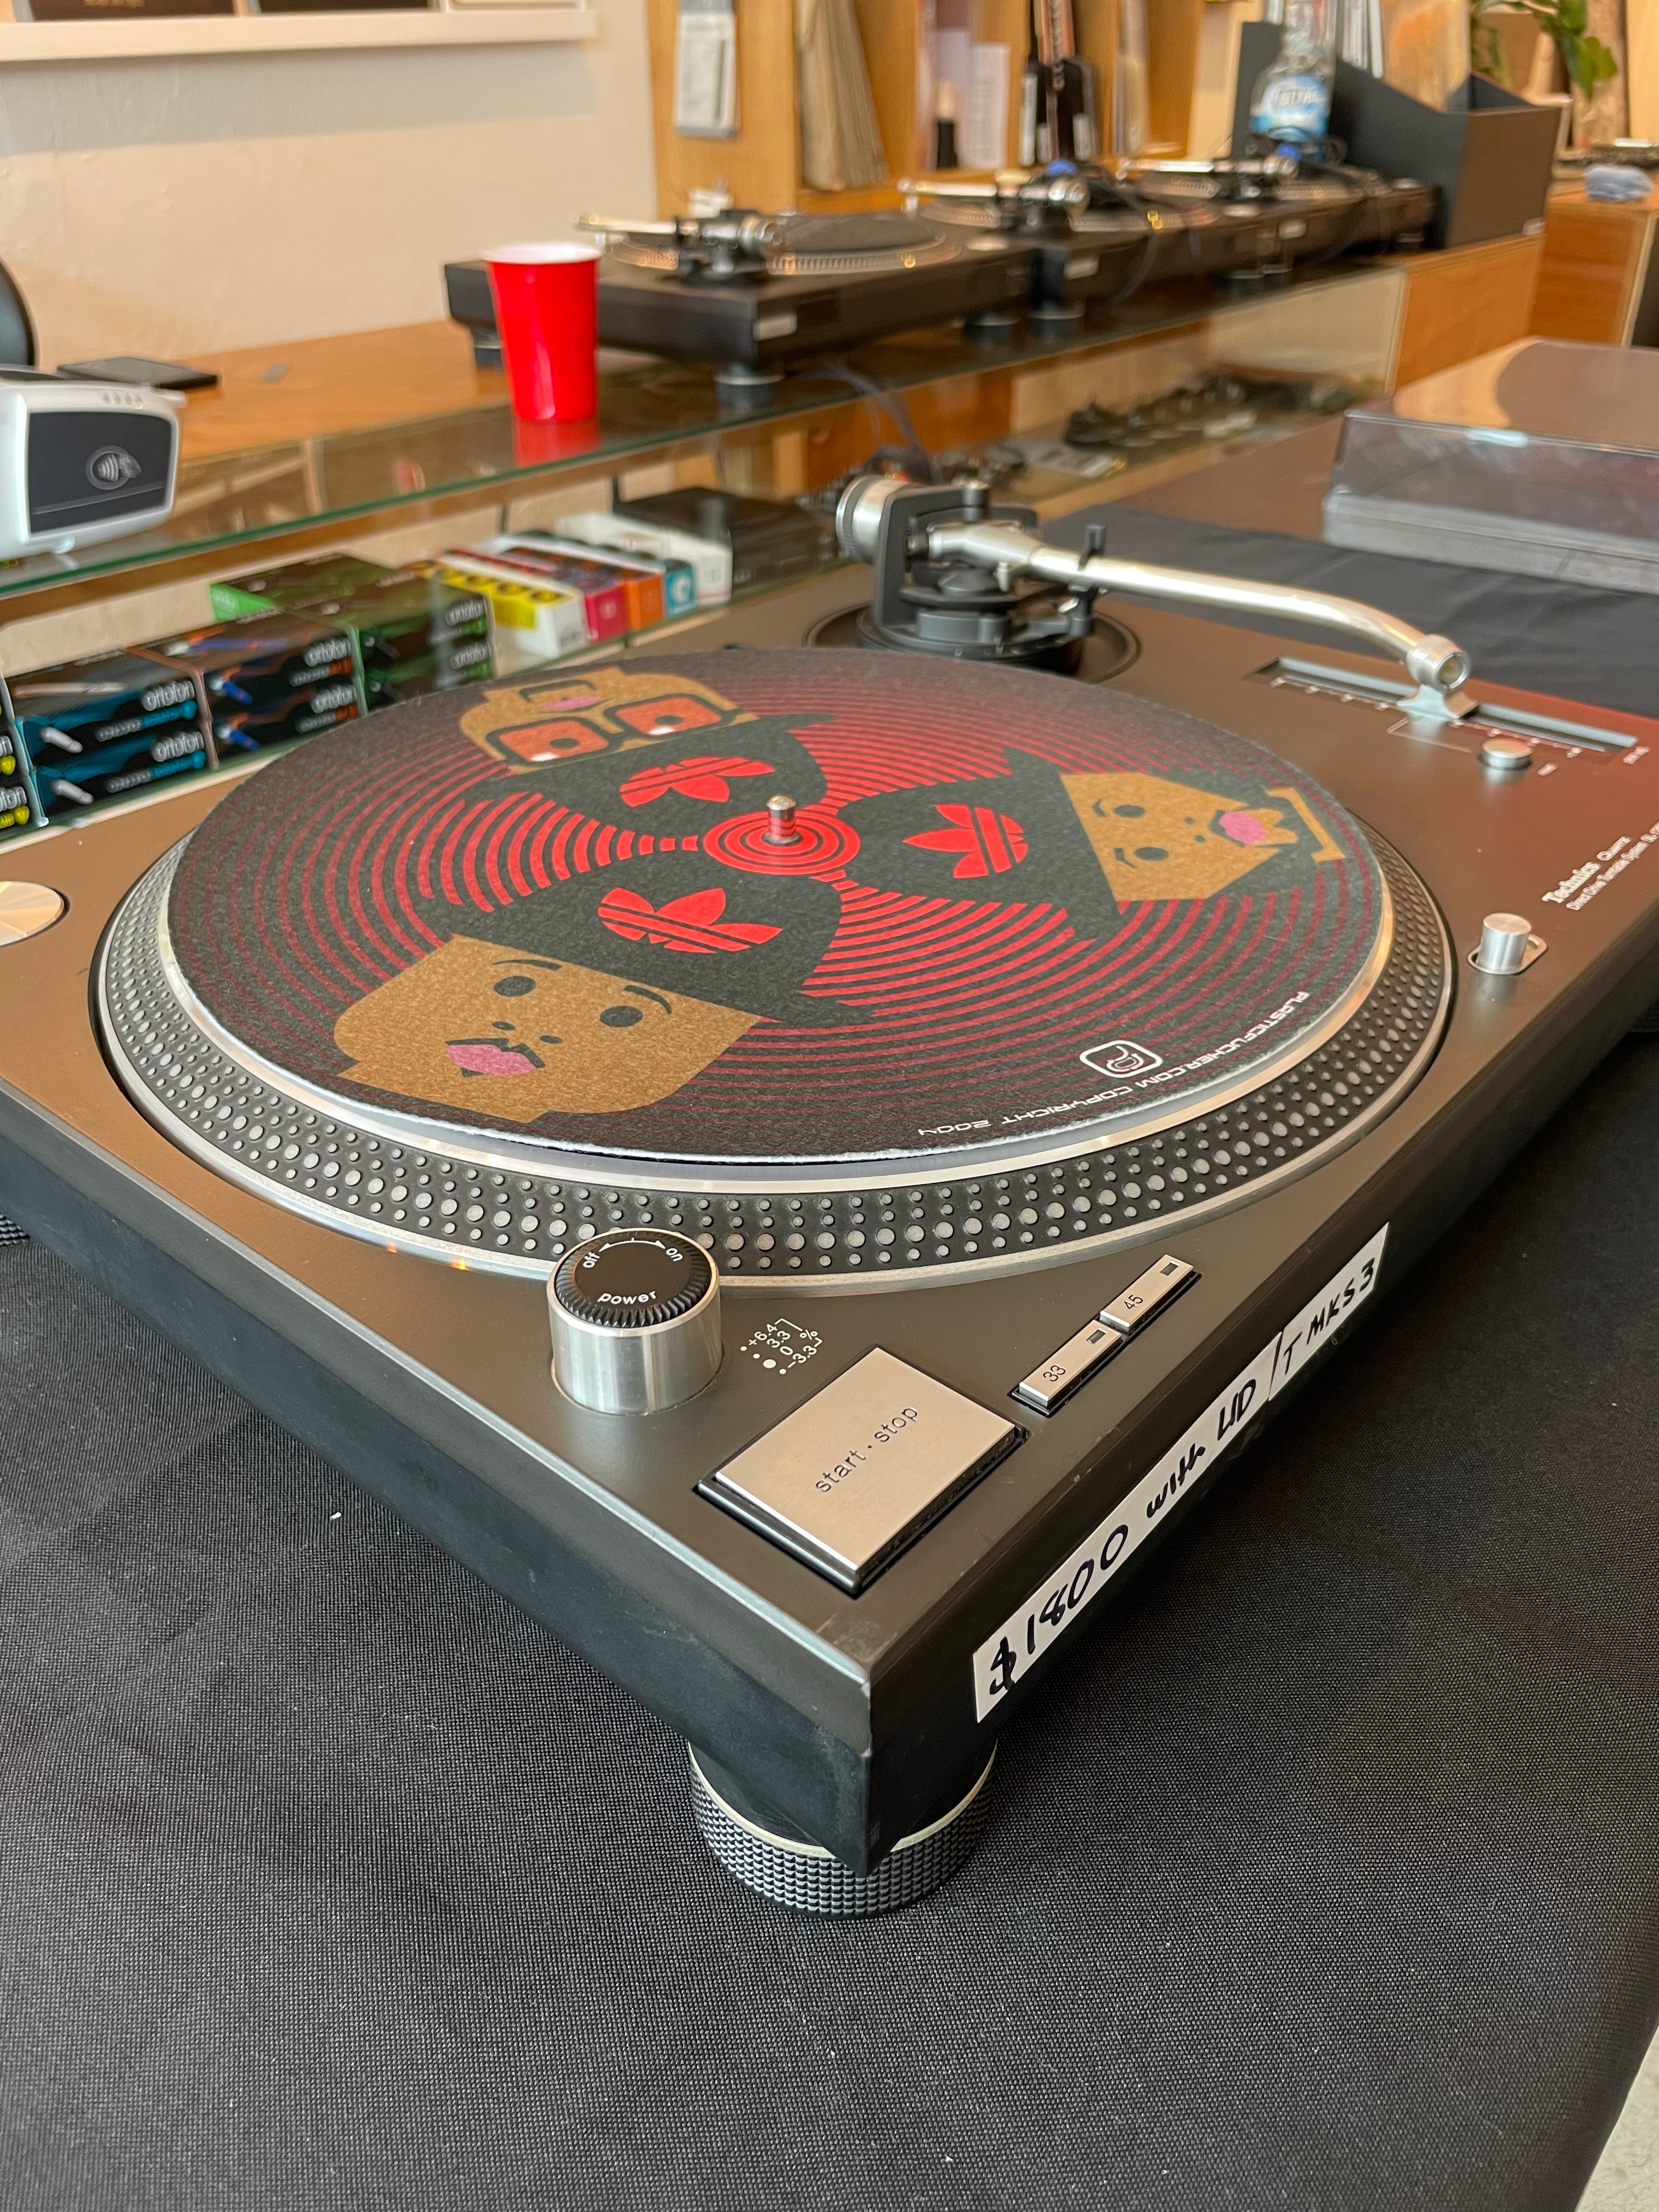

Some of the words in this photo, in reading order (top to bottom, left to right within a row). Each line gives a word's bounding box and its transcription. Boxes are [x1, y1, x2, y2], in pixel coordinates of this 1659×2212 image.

[1542, 861, 1601, 904] Technics
[1001, 1086, 1133, 1124] COPYRIGHT
[917, 1120, 991, 1136] 2004
[583, 1251, 601, 1268] off
[665, 1248, 684, 1262] on
[597, 1290, 657, 1305] power
[1124, 1294, 1144, 1310] 45
[766, 1330, 791, 1348] 3.3
[779, 1346, 794, 1356] 0
[1043, 1365, 1066, 1382] 33
[989, 1525, 1128, 1695] $1800
[1147, 1443, 1206, 1519] with
